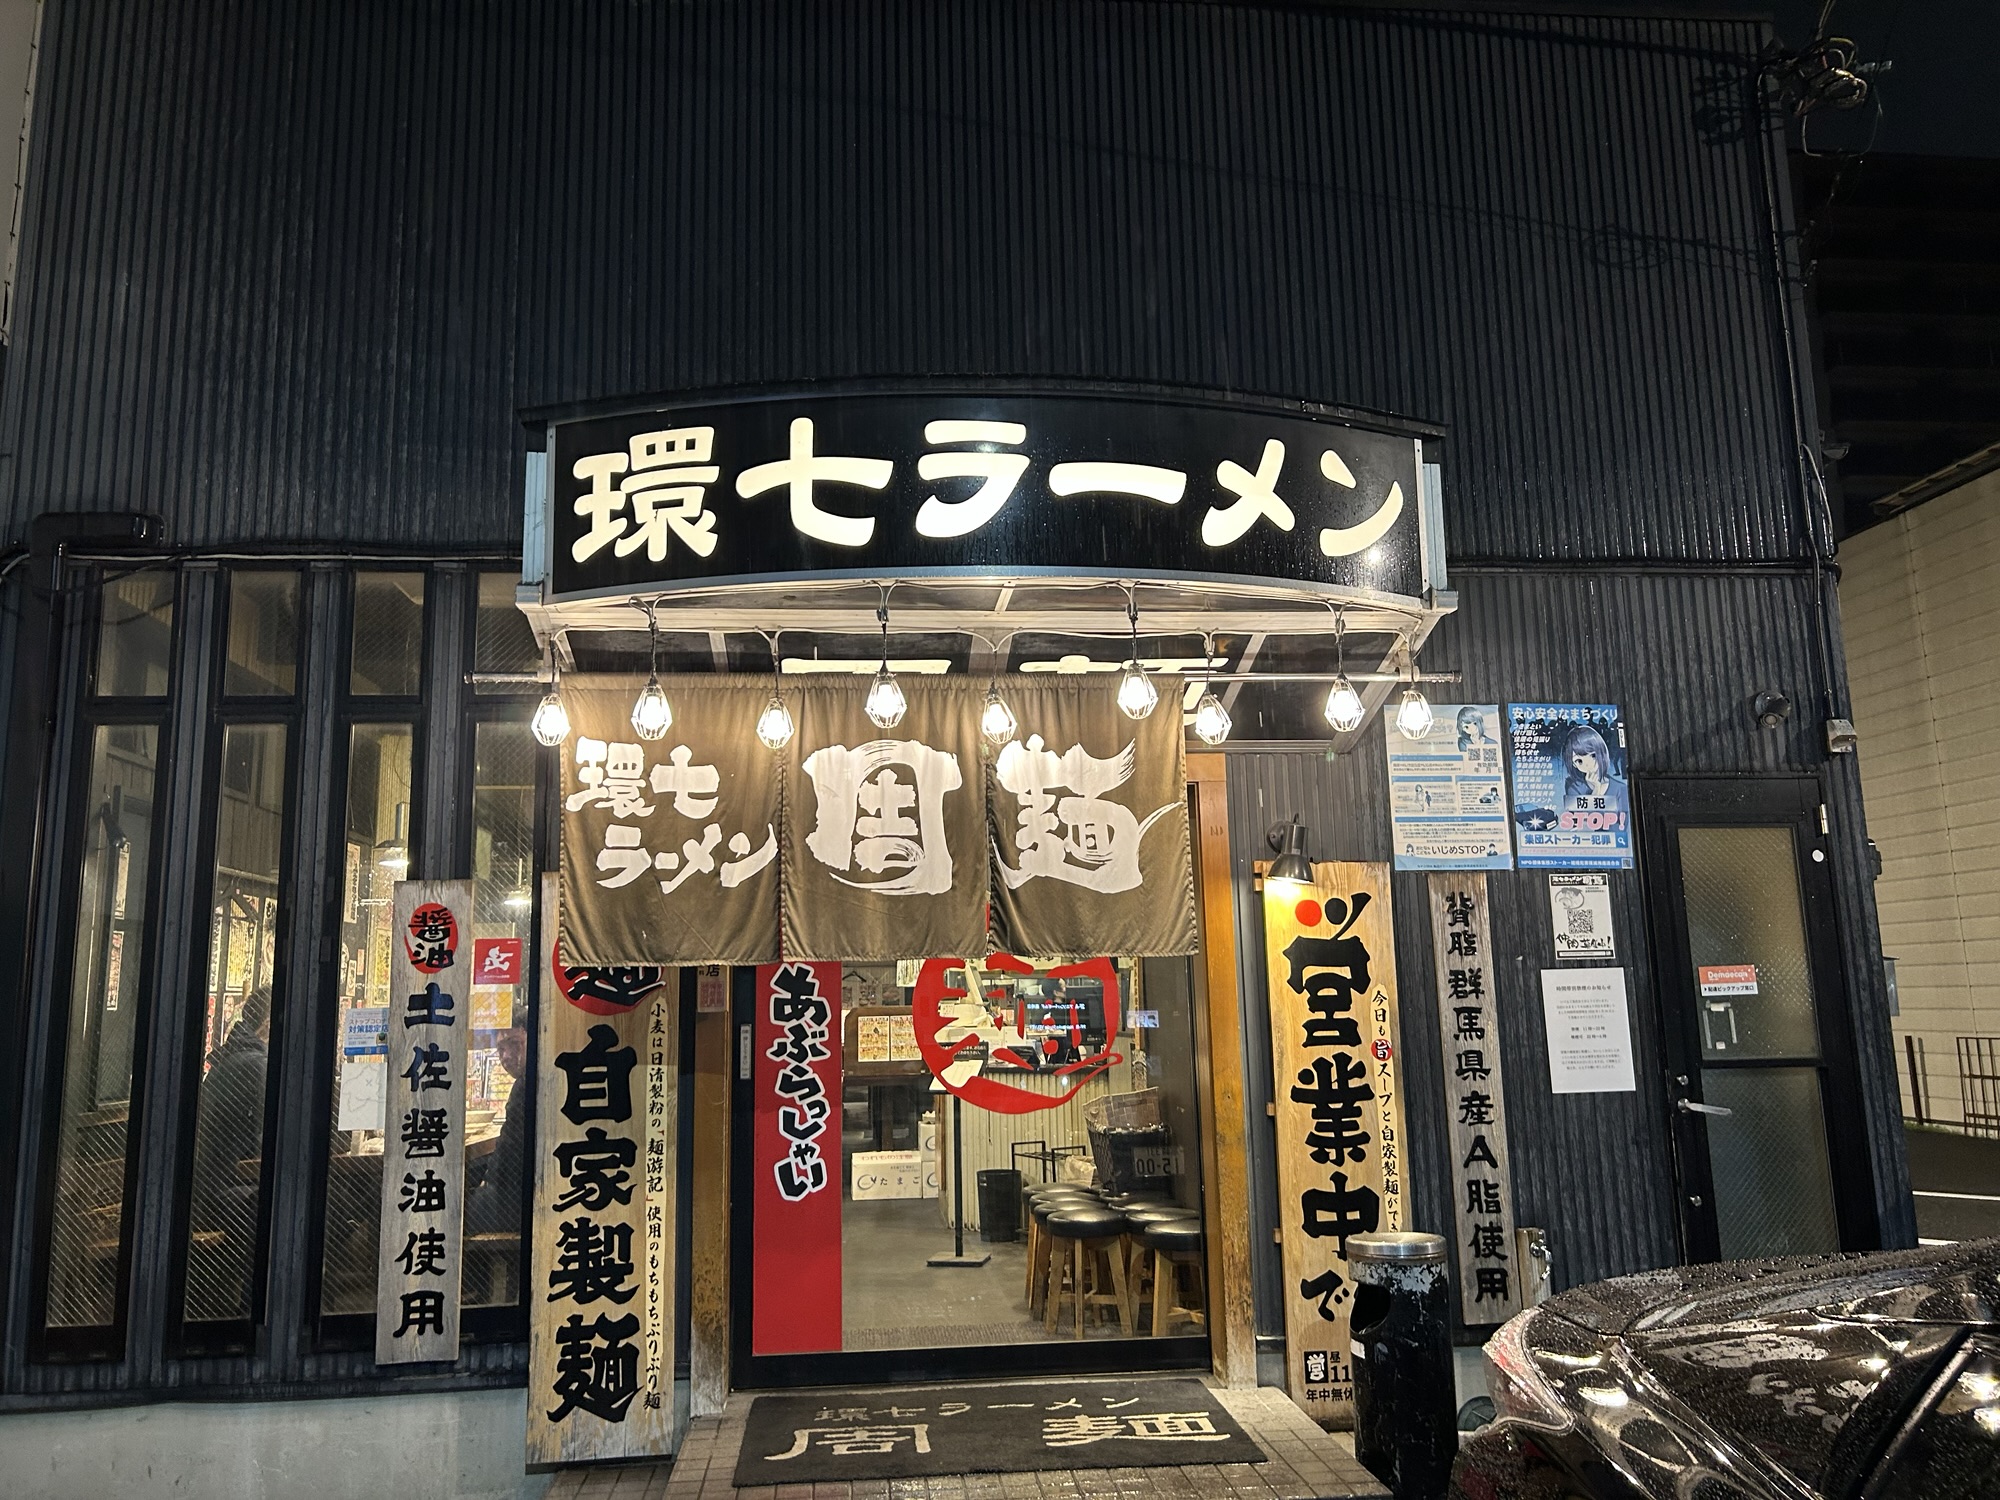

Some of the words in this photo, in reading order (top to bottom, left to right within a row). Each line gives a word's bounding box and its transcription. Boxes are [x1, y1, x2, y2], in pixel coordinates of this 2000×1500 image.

[571, 417, 1404, 562] 環七ラーメン
[1512, 707, 1618, 720] 安心安全なまちづくり
[565, 736, 721, 820] 環七
[1576, 797, 1606, 809] 防犯
[1432, 845, 1486, 855] いじめSTOP
[1524, 834, 1612, 846] 集団ストーカー犯罪
[1560, 811, 1626, 831] STOP!
[595, 822, 779, 895] ラーメン
[408, 907, 455, 969] 醤油
[1708, 970, 1748, 979] Demaecan
[768, 964, 830, 1200] あぶらっしゃい
[1446, 892, 1509, 1304] 背脂群馬県産A脂使用
[393, 982, 457, 1338] 土佐醤油使用
[546, 1024, 643, 1424] 自家製麺
[814, 1397, 1139, 1422] 環七ラーメン
